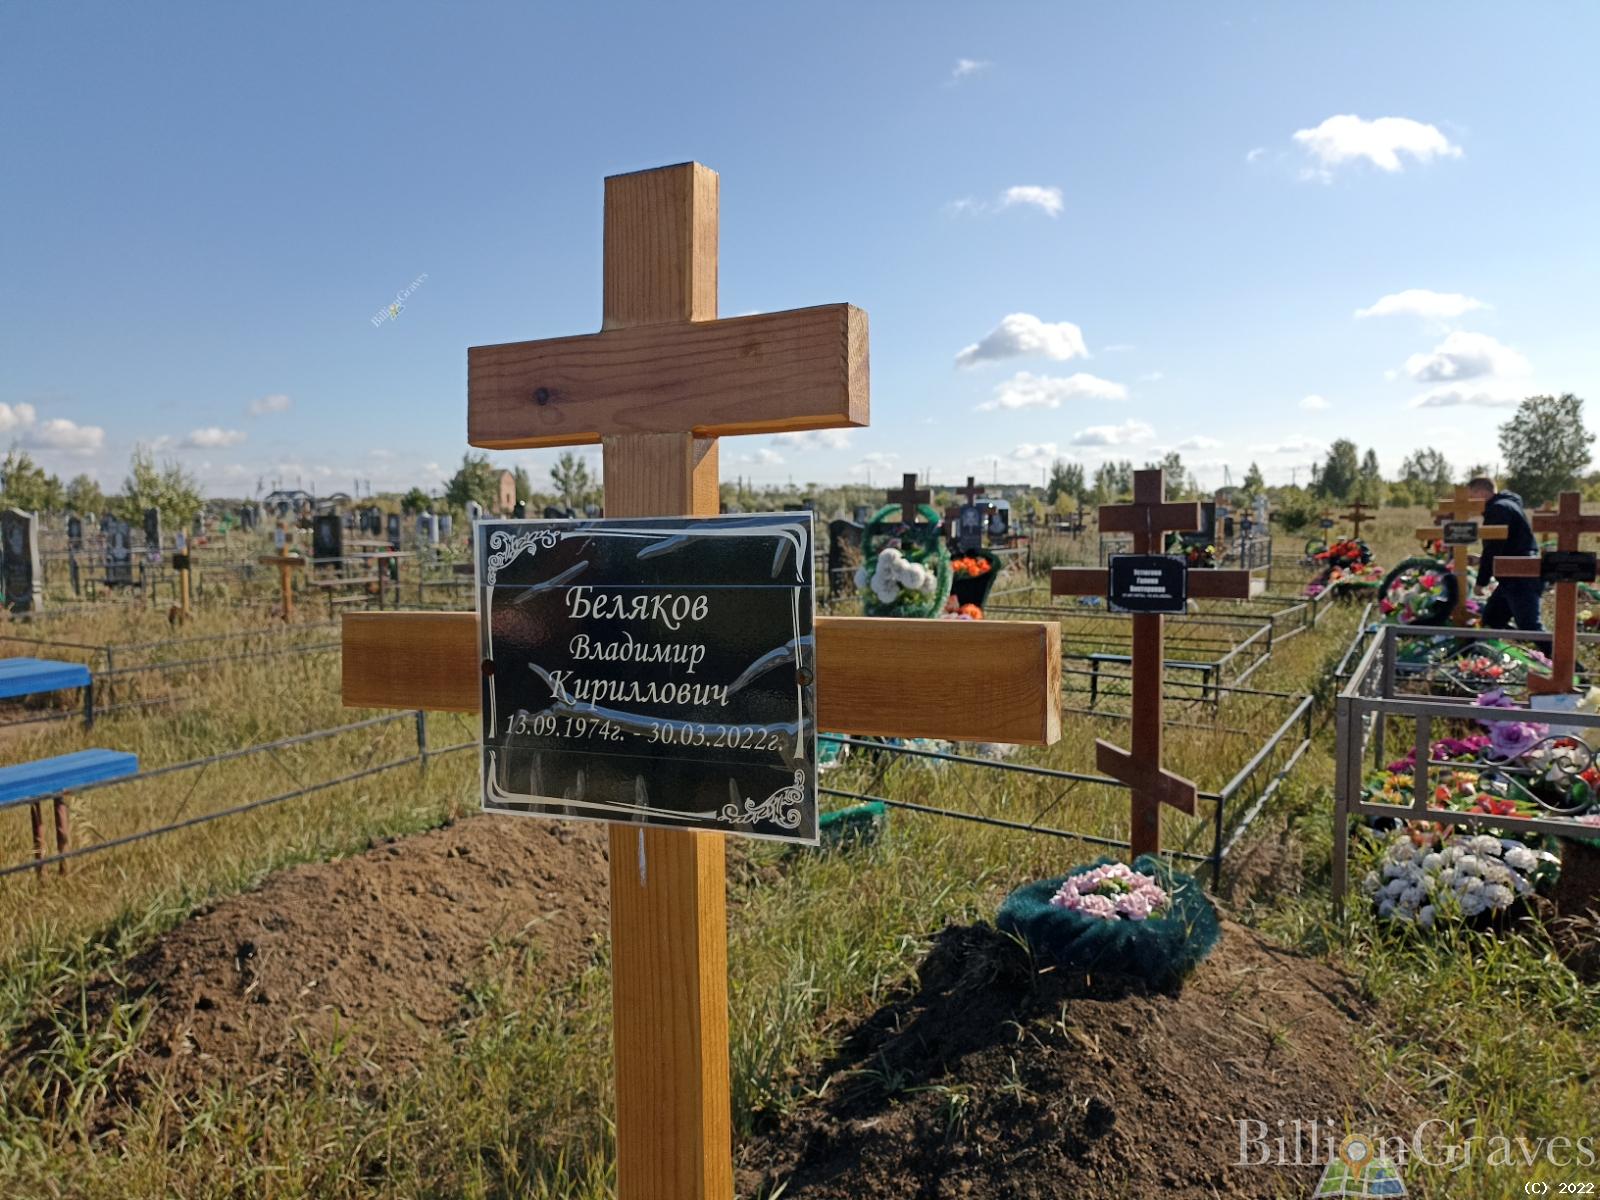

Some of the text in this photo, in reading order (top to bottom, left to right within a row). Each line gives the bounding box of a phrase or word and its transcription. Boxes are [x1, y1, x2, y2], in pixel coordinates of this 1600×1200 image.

[565, 585, 709, 630] Беляков
[568, 631, 706, 674] Владимир
[549, 669, 730, 711] Кириллович
[504, 714, 625, 742] 13.09.1974г.
[646, 722, 784, 752] 30.03.2022г.
